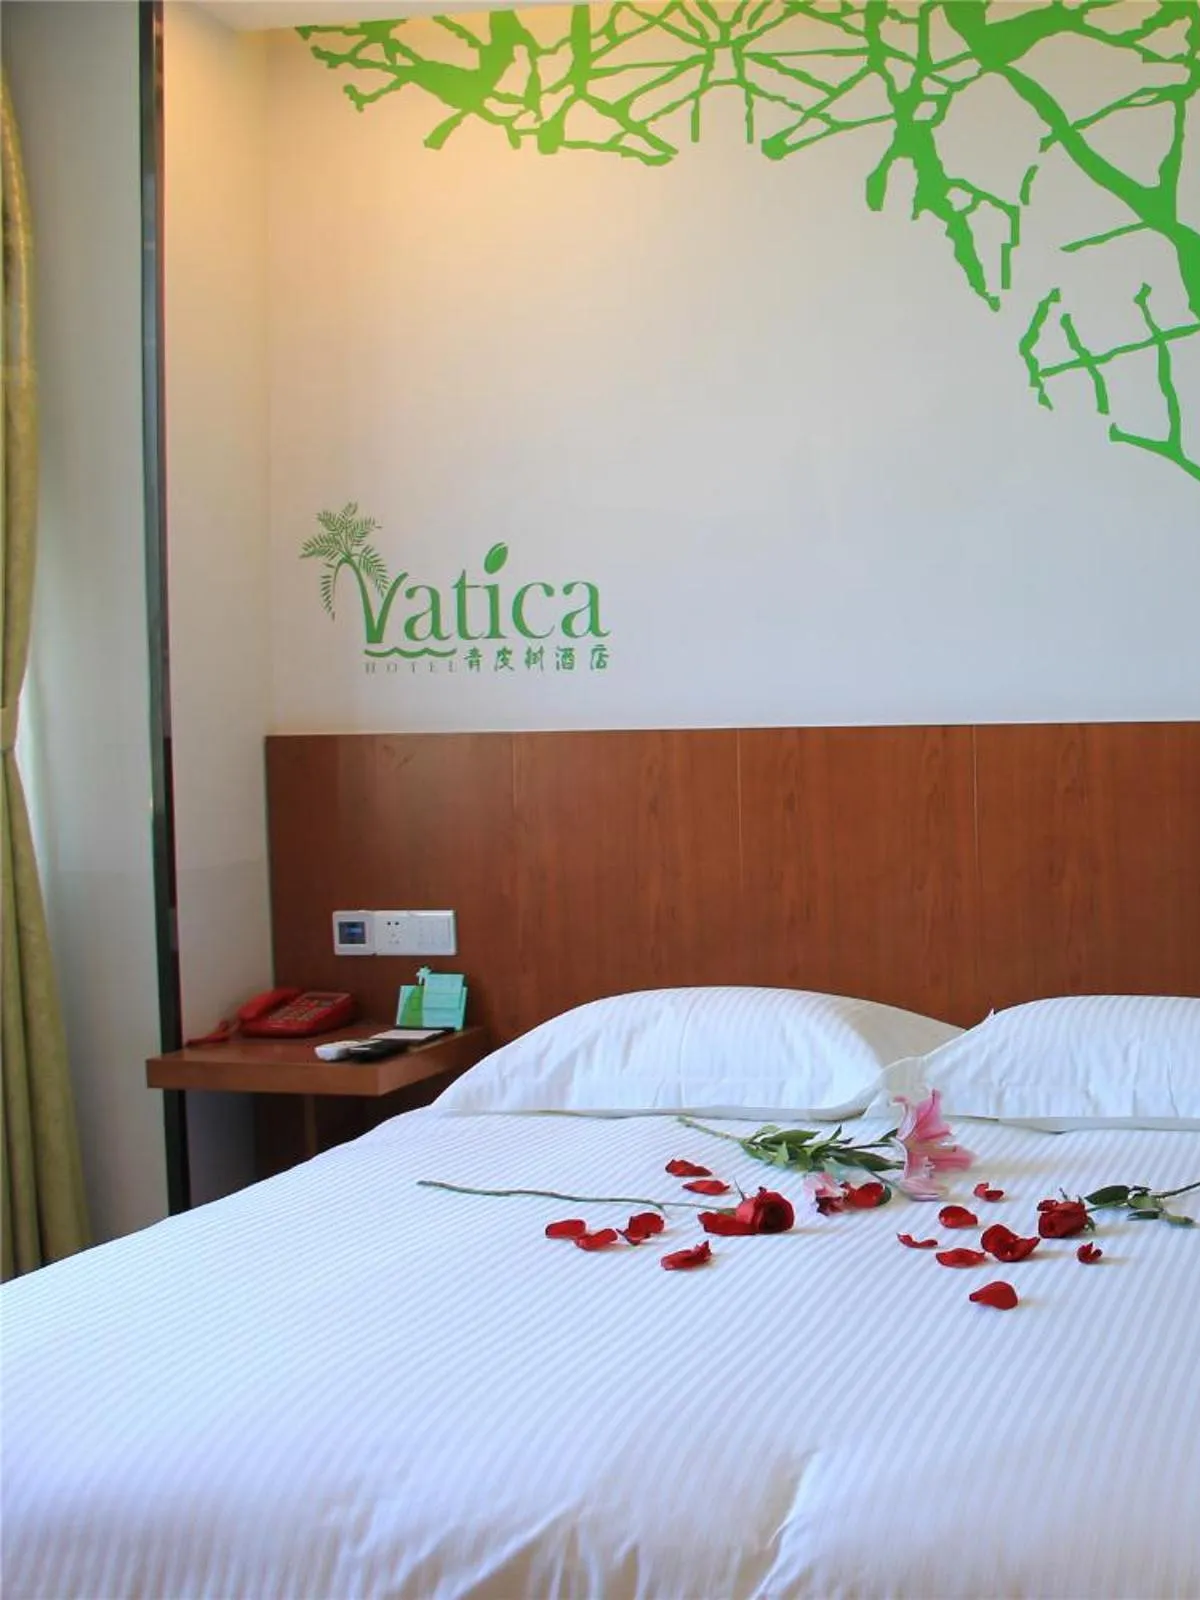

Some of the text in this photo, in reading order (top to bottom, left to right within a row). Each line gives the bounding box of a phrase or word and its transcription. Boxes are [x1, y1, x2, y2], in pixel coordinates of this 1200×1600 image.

[346, 542, 611, 644] Vatica
[364, 661, 457, 673] HOTEL
[463, 645, 609, 671] 青皮树酒店
